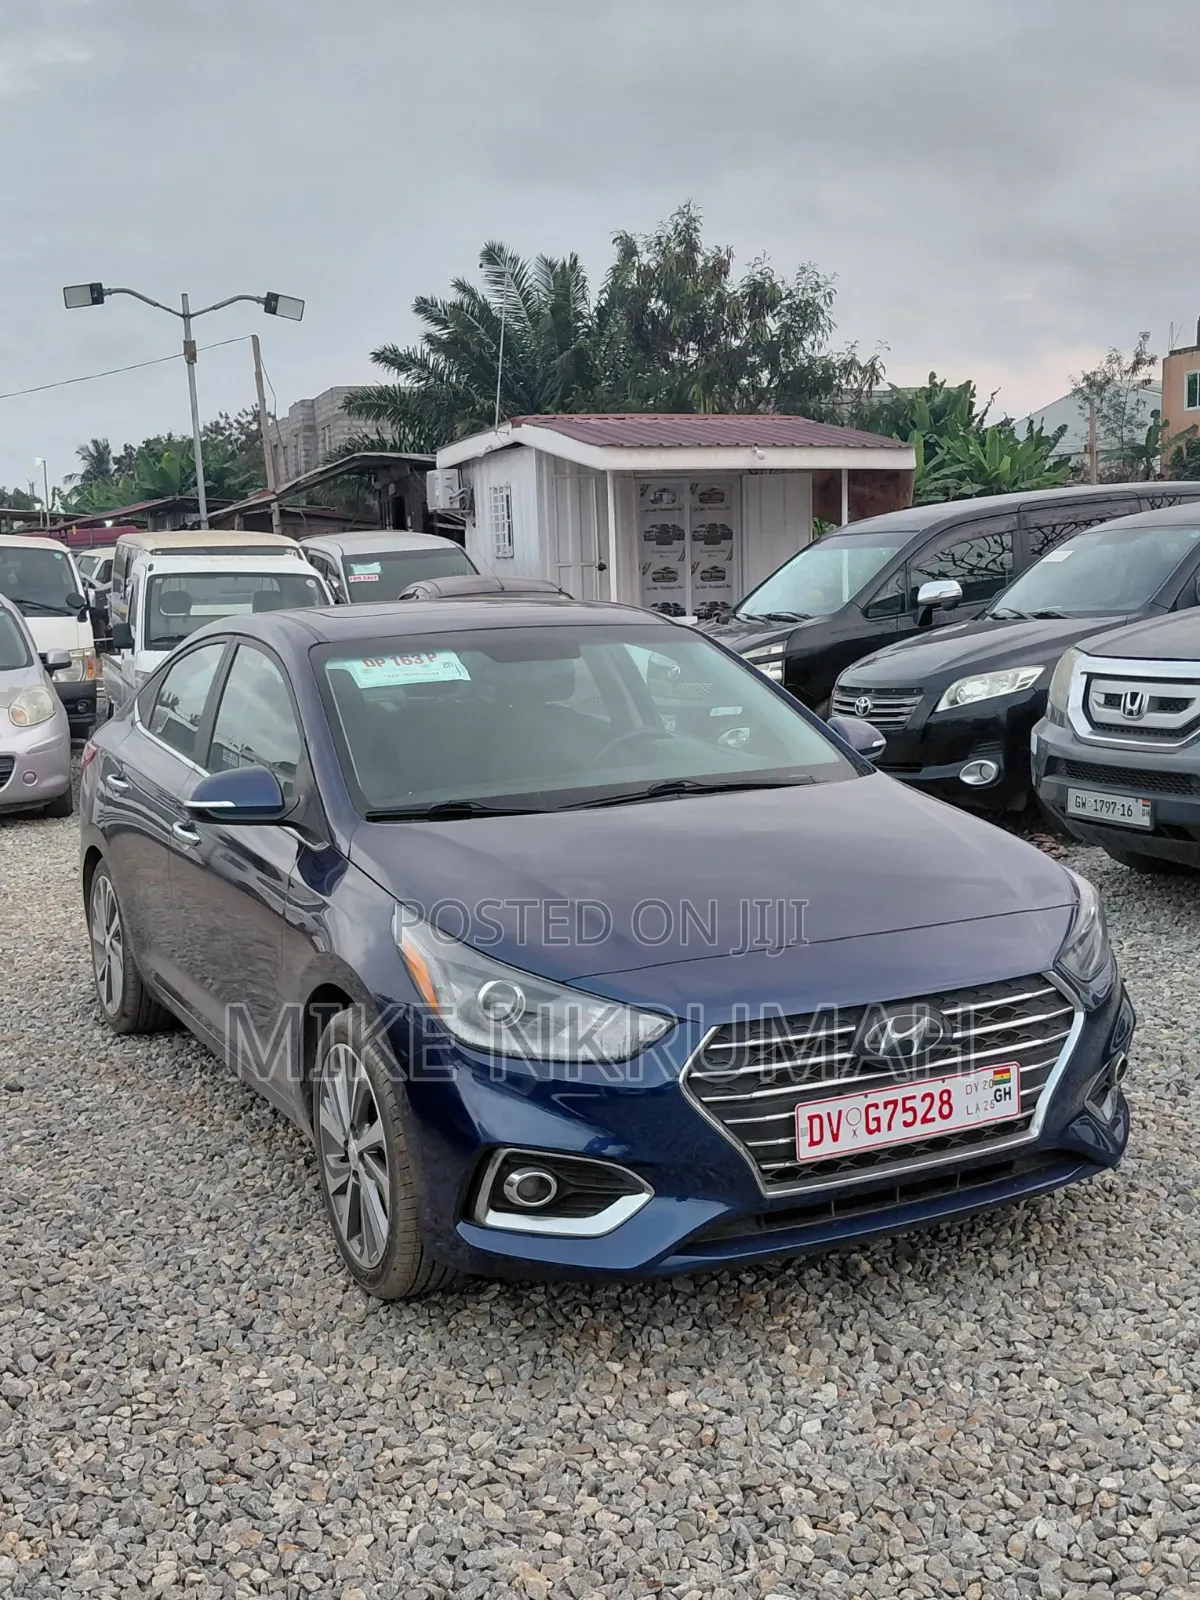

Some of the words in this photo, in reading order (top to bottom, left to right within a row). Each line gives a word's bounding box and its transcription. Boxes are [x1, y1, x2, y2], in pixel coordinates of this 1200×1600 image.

[390, 652, 424, 666] 163
[425, 651, 437, 662] P
[1075, 795, 1086, 810] GW
[1093, 799, 1133, 817] 1797-16
[993, 1086, 1012, 1103] GH
[807, 1108, 843, 1148] DV
[864, 1088, 954, 1136] G7528
